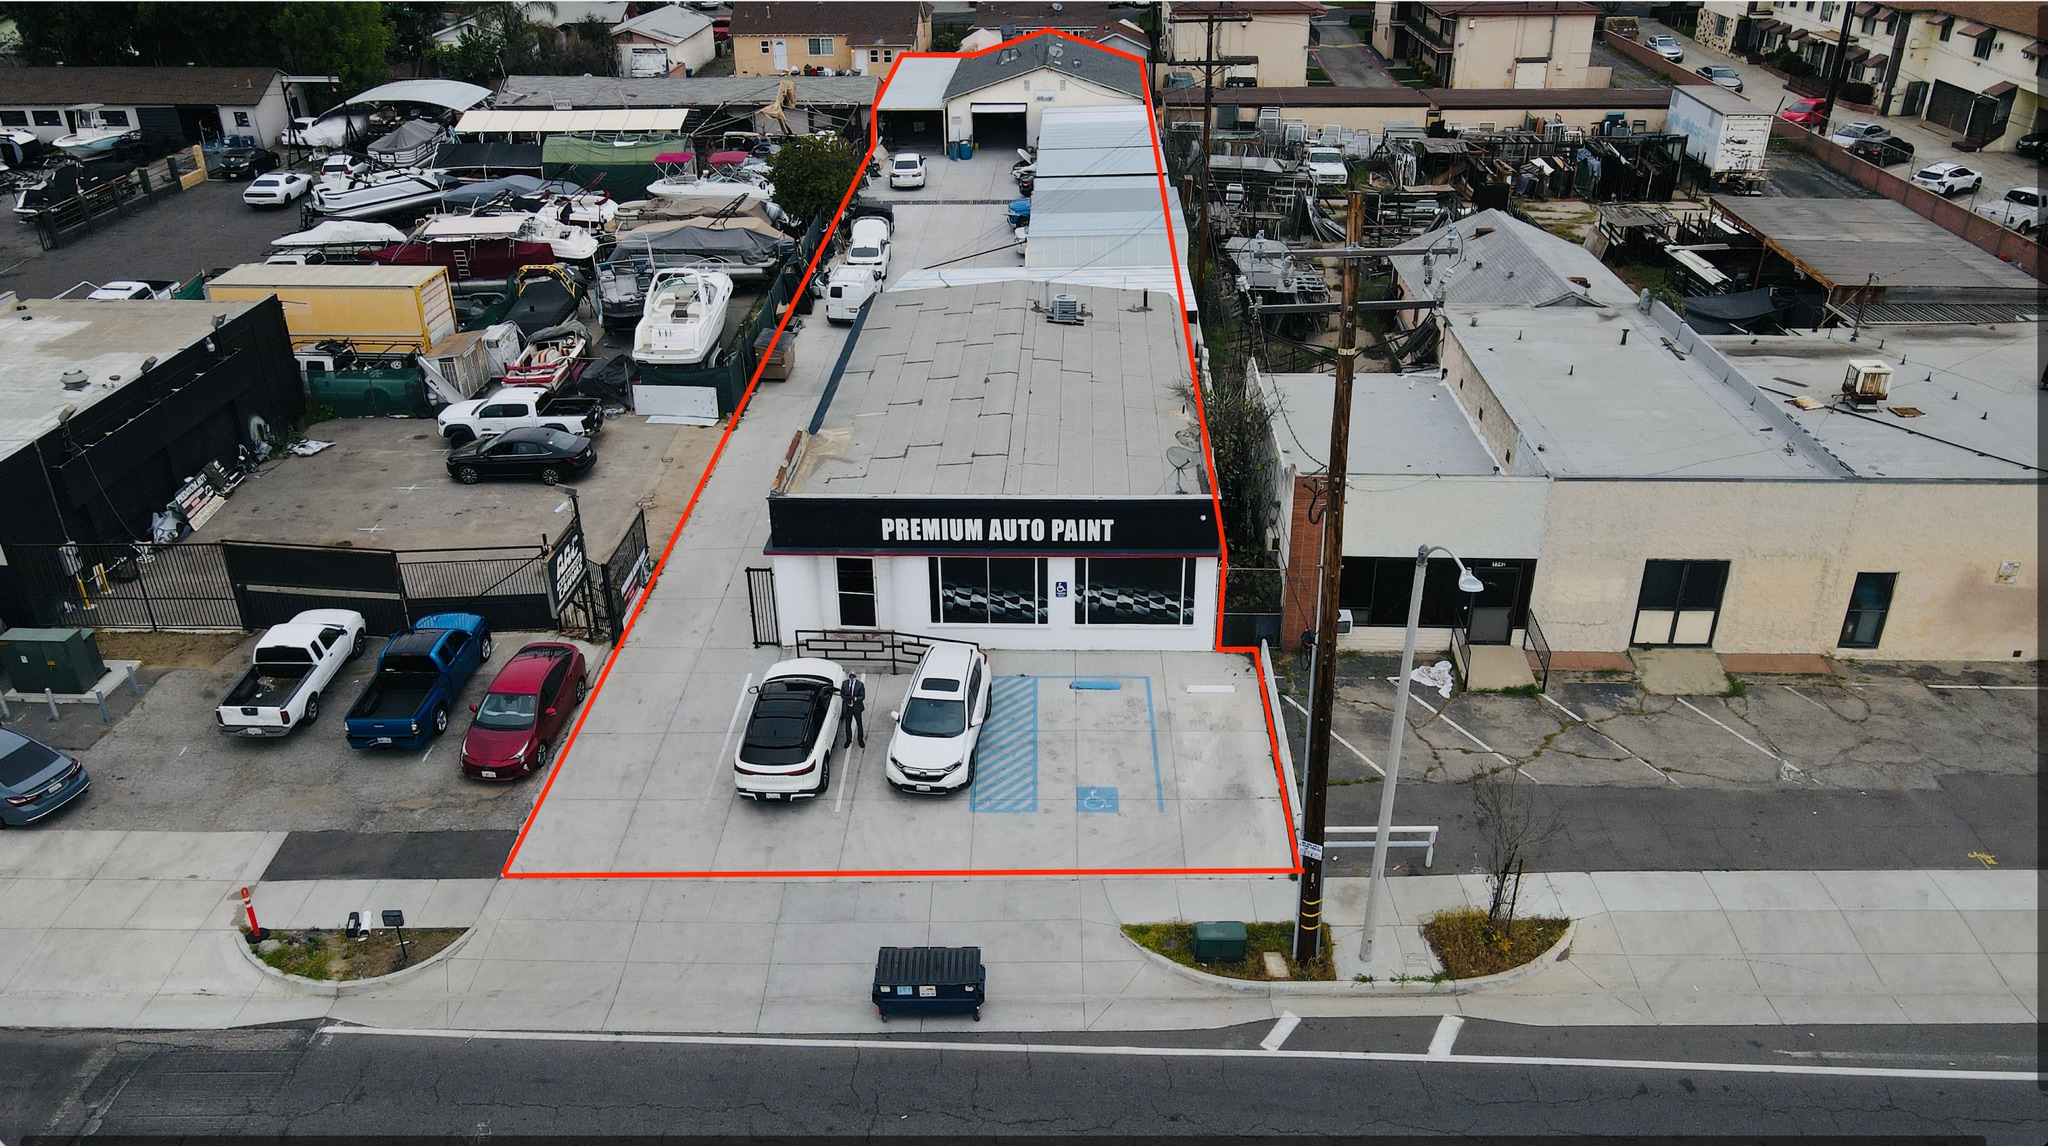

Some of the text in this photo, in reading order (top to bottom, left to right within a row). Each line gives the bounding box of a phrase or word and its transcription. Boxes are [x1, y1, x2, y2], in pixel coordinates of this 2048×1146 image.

[881, 518, 1115, 542] PREMIUM AUTO PAINT
